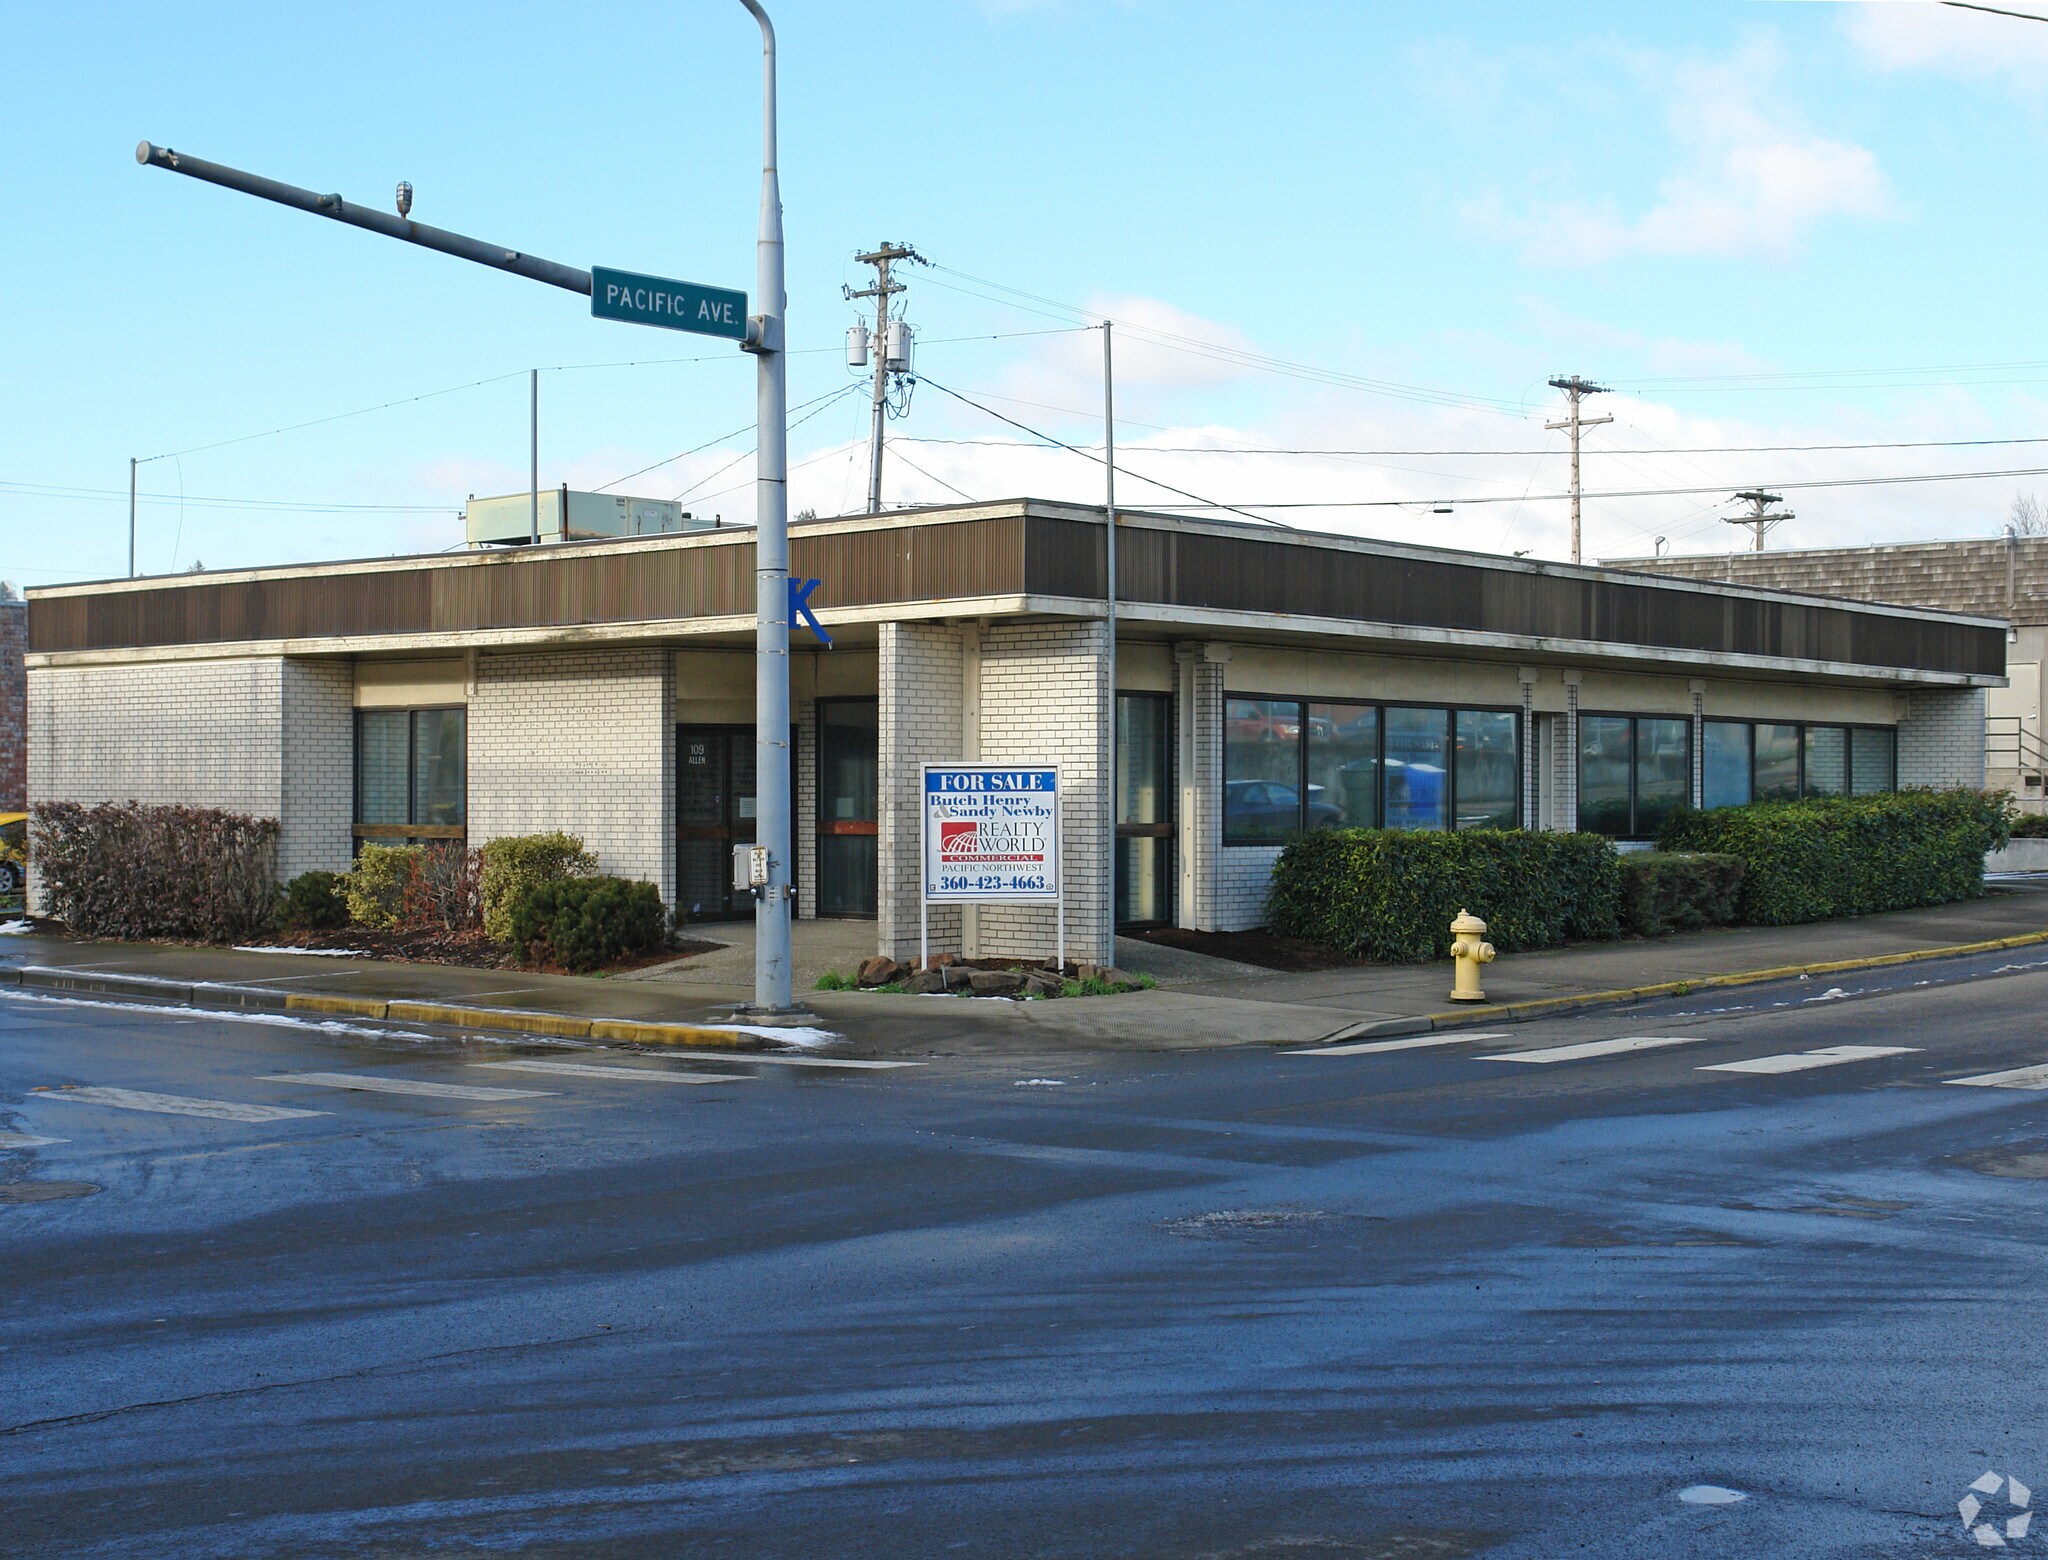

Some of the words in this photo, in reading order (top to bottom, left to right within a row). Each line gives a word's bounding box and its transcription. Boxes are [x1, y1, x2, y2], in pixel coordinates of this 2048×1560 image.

[607, 284, 685, 316] PACIFIC
[697, 299, 739, 325] AVE.
[690, 744, 704, 755] 109
[688, 756, 706, 764] ALLEN
[940, 775, 985, 790] FOR
[991, 774, 1043, 790] SALE
[931, 795, 977, 805] Butch
[982, 795, 1031, 807] Henry
[933, 805, 951, 819] &
[949, 805, 997, 819] Sandy
[1002, 805, 1053, 819] Newby
[979, 822, 1043, 836] REALTY
[979, 837, 1045, 852] WORLD
[942, 864, 981, 872] PACIFIC
[982, 864, 1044, 872] NORTHWEST
[940, 875, 1045, 890] 360-423-4663
